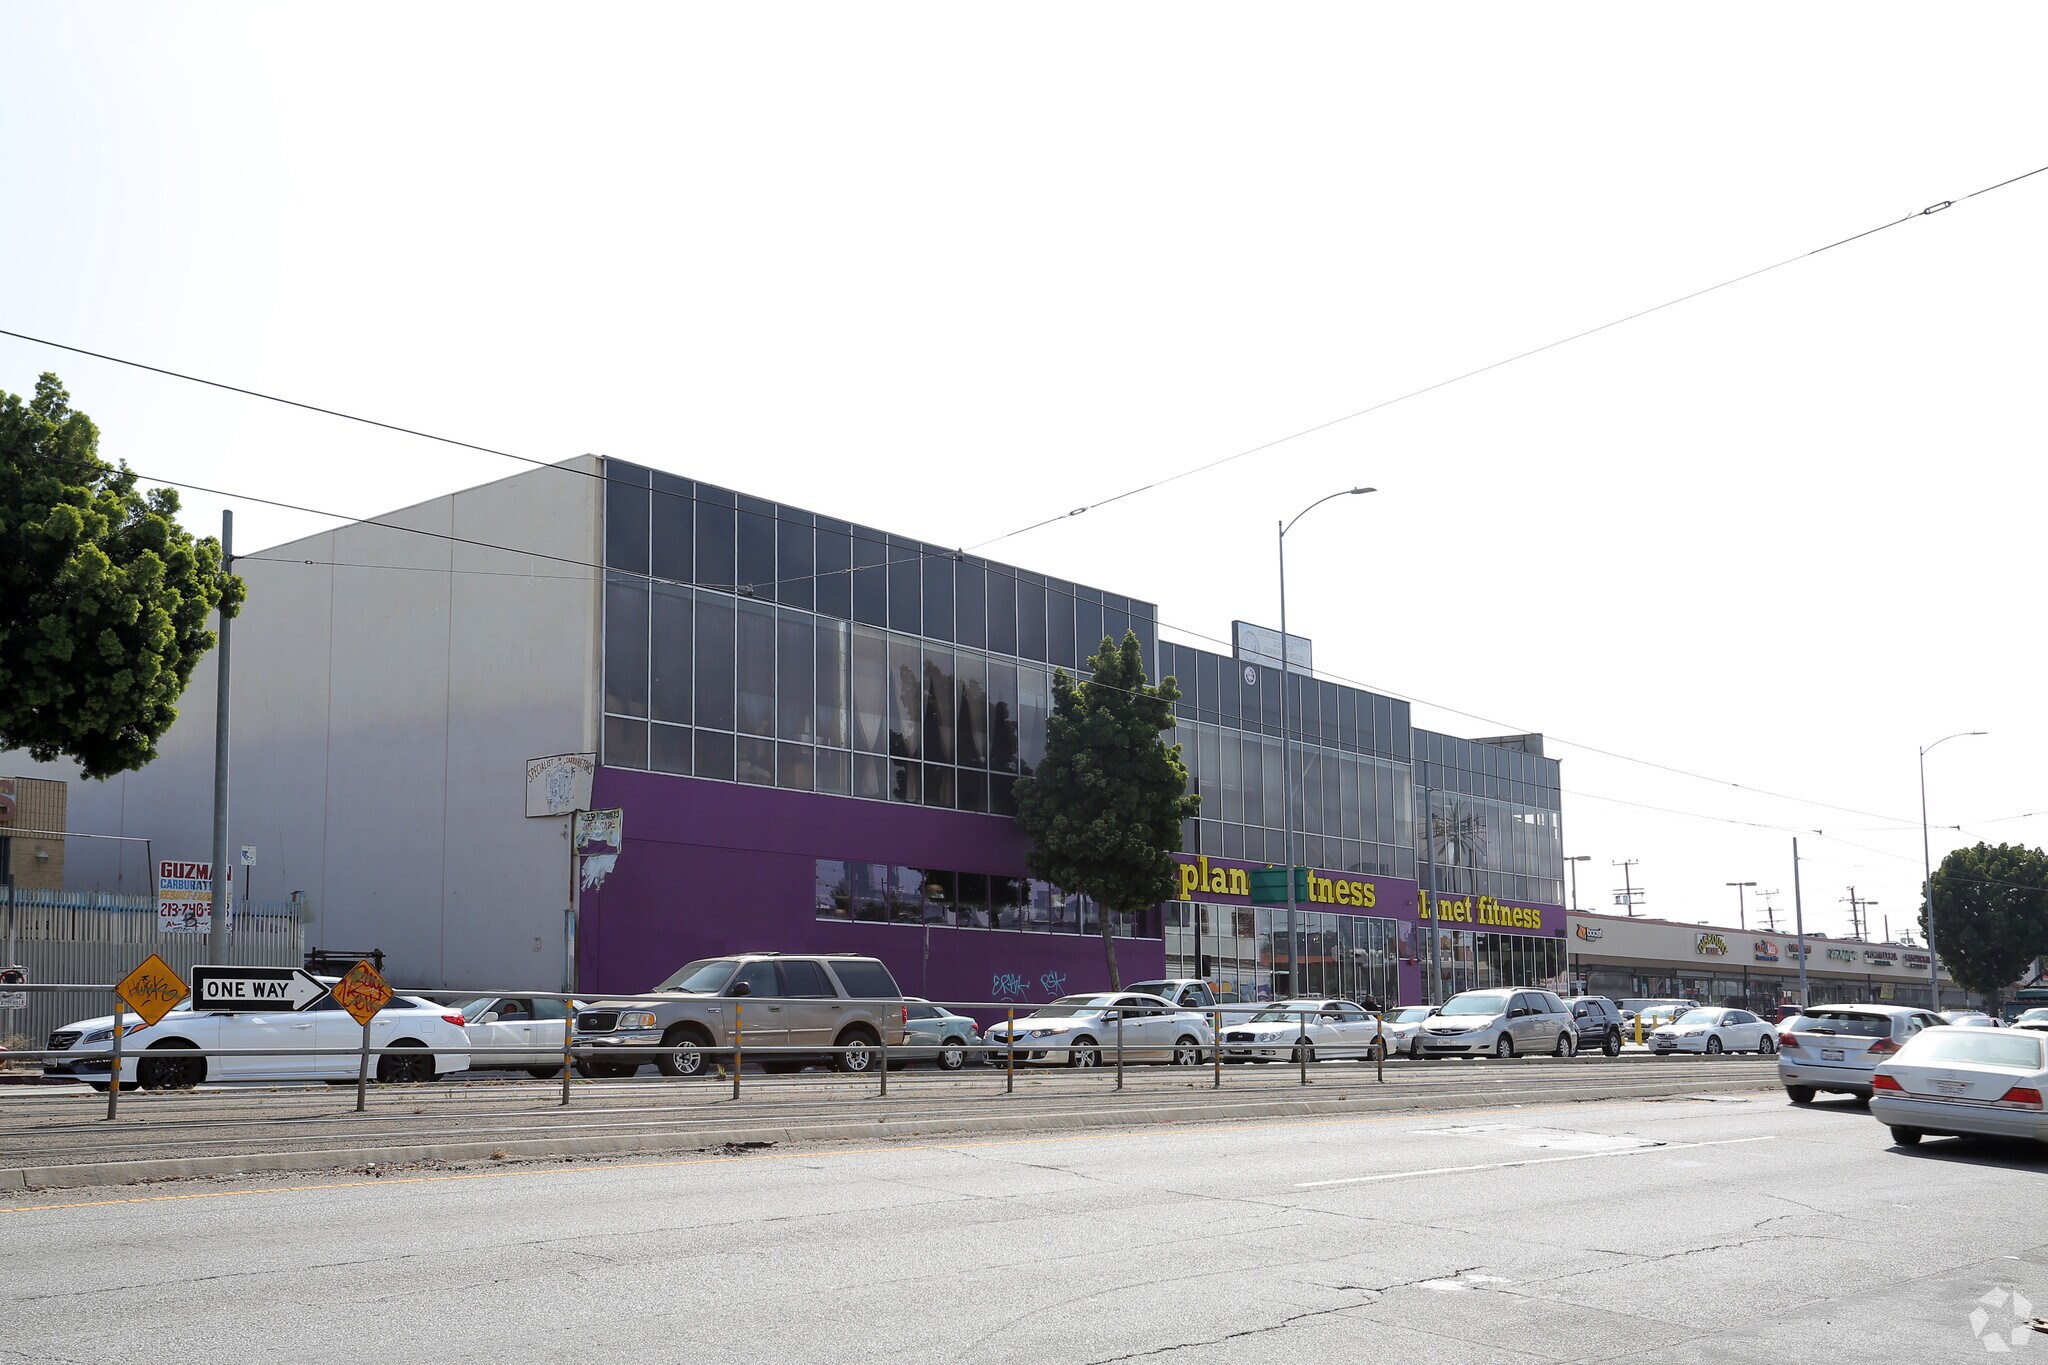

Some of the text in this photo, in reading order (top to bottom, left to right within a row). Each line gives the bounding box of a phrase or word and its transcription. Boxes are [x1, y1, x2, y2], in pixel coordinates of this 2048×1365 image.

[528, 758, 554, 783] SPECIALIST
[161, 861, 232, 881] GUZMN
[1178, 855, 1376, 908] plan tness
[1418, 890, 1542, 930] lnet fitness
[1586, 927, 1603, 939] boost
[207, 981, 289, 998] ONE WAY
